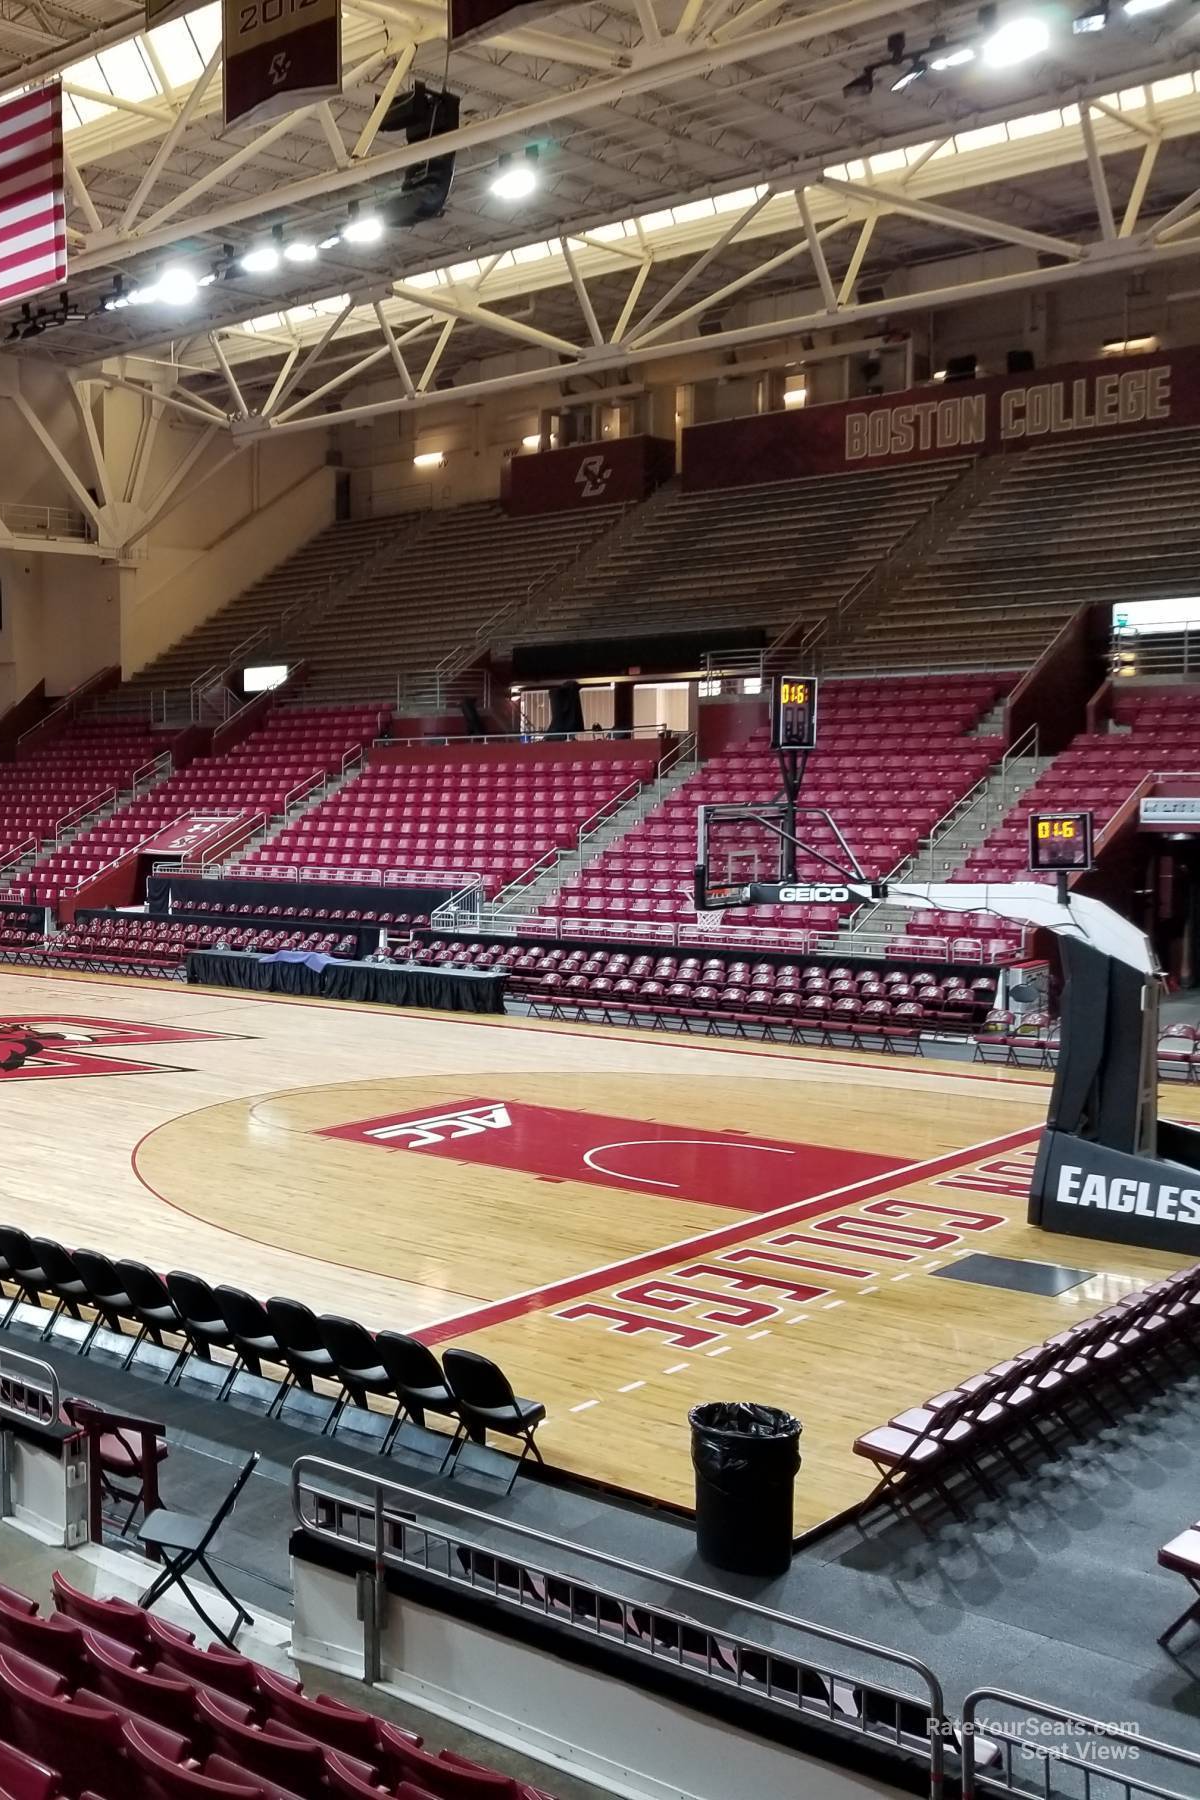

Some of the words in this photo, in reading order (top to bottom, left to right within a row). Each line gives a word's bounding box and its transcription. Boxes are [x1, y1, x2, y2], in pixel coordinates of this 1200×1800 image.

[240, 0, 316, 34] 201
[845, 393, 987, 461] BOSTON
[1000, 365, 1172, 441] COLLEGE
[779, 887, 849, 902] GEICO
[372, 1105, 512, 1149] ACC
[1056, 1164, 1200, 1225] EAGLES
[551, 1197, 1010, 1350] COLLEGE
